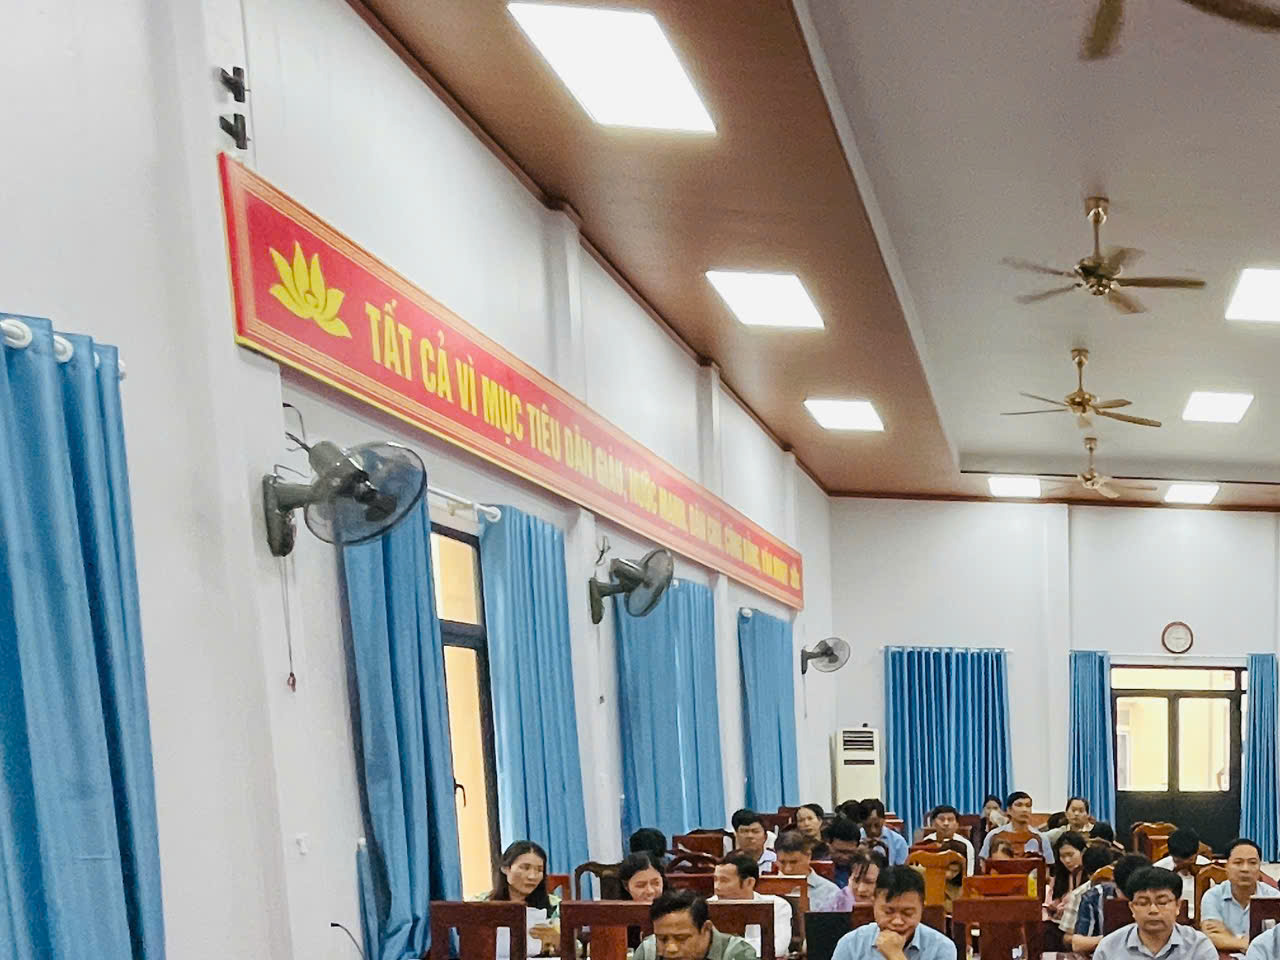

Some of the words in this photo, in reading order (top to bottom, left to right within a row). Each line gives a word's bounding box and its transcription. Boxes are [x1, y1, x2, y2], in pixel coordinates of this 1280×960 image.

[365, 299, 412, 381] TẤT
[420, 330, 453, 404] CẢ
[456, 352, 478, 417] VÌ
[480, 374, 525, 445] MỤC
[526, 403, 561, 462] TIÊU
